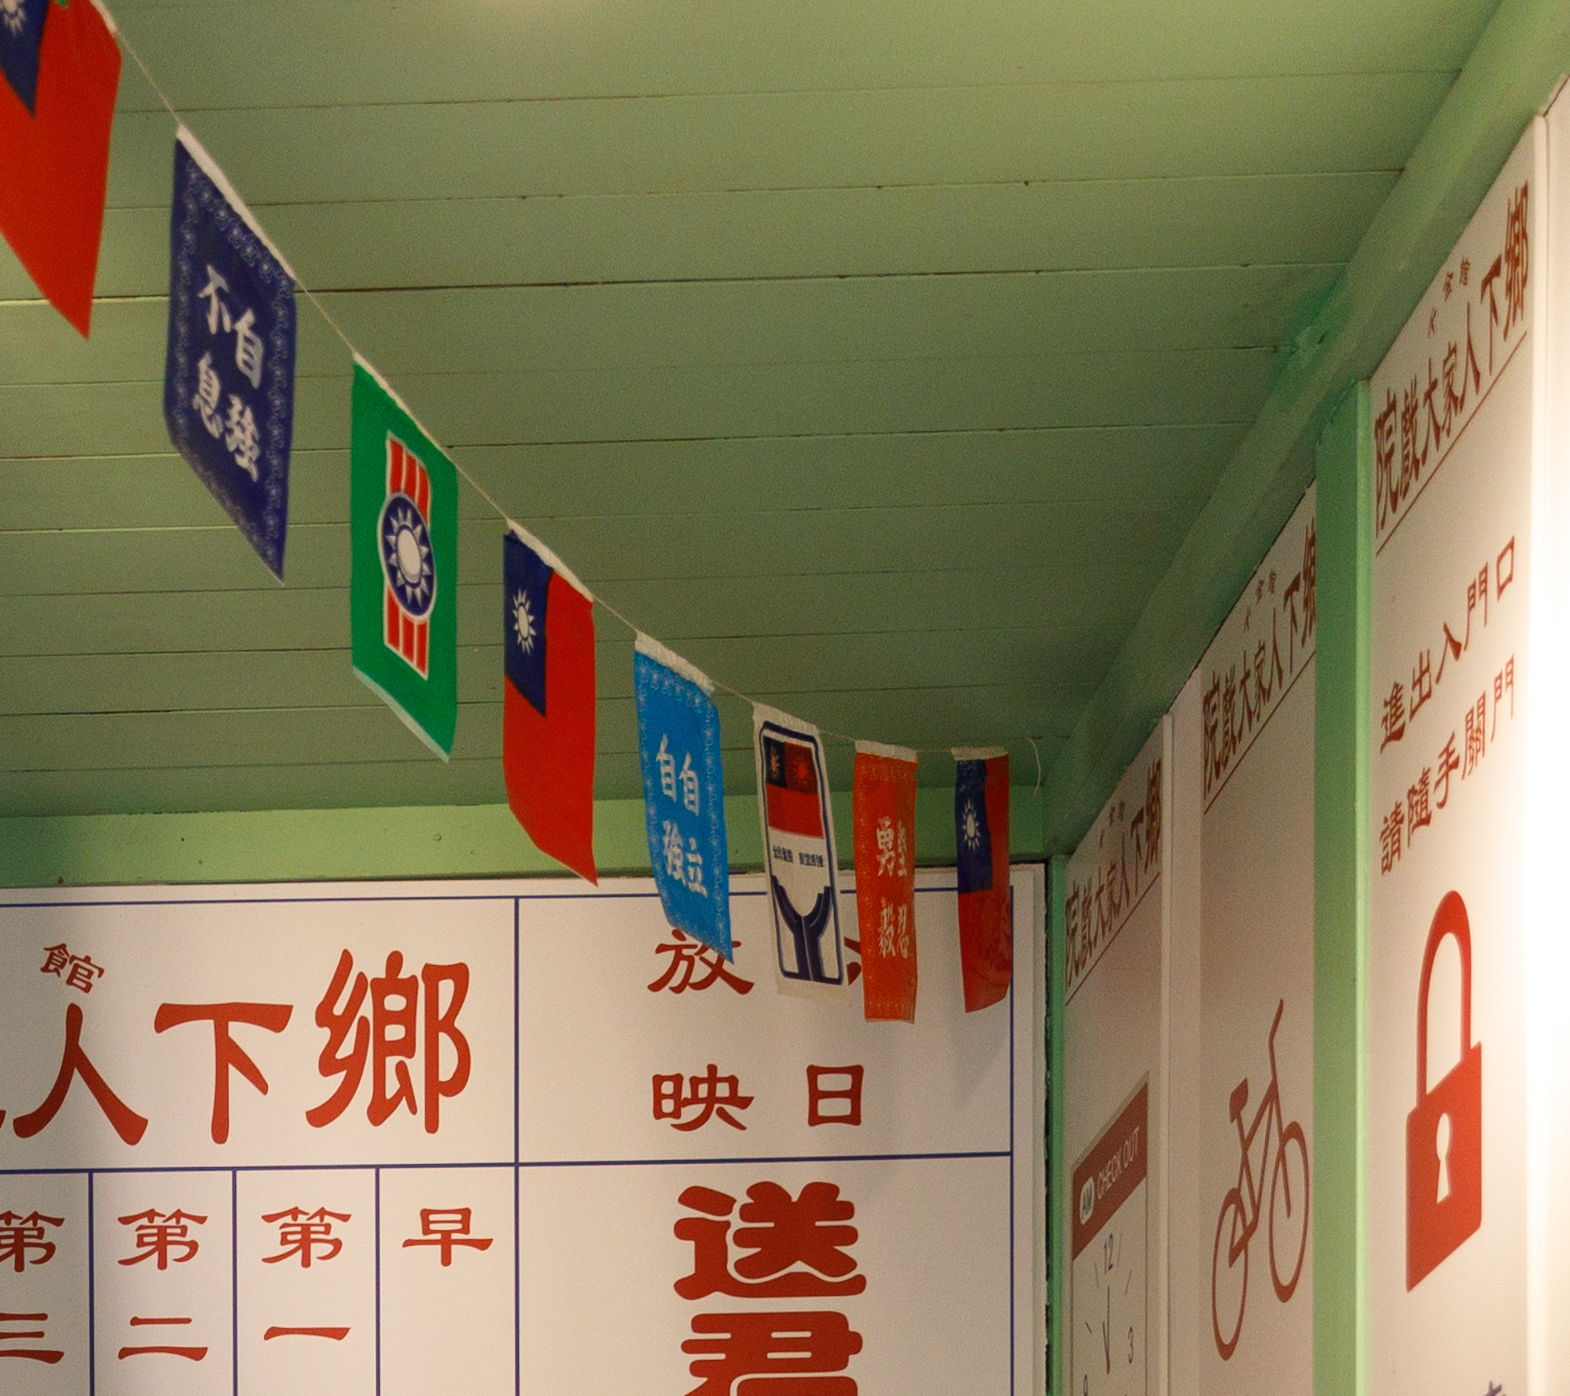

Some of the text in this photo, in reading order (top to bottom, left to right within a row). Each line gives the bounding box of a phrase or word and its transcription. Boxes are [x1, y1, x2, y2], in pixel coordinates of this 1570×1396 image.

[1379, 534, 1515, 755] 進出入門口
[1102, 1232, 1115, 1275] 12
[1127, 1327, 1136, 1364] 3
